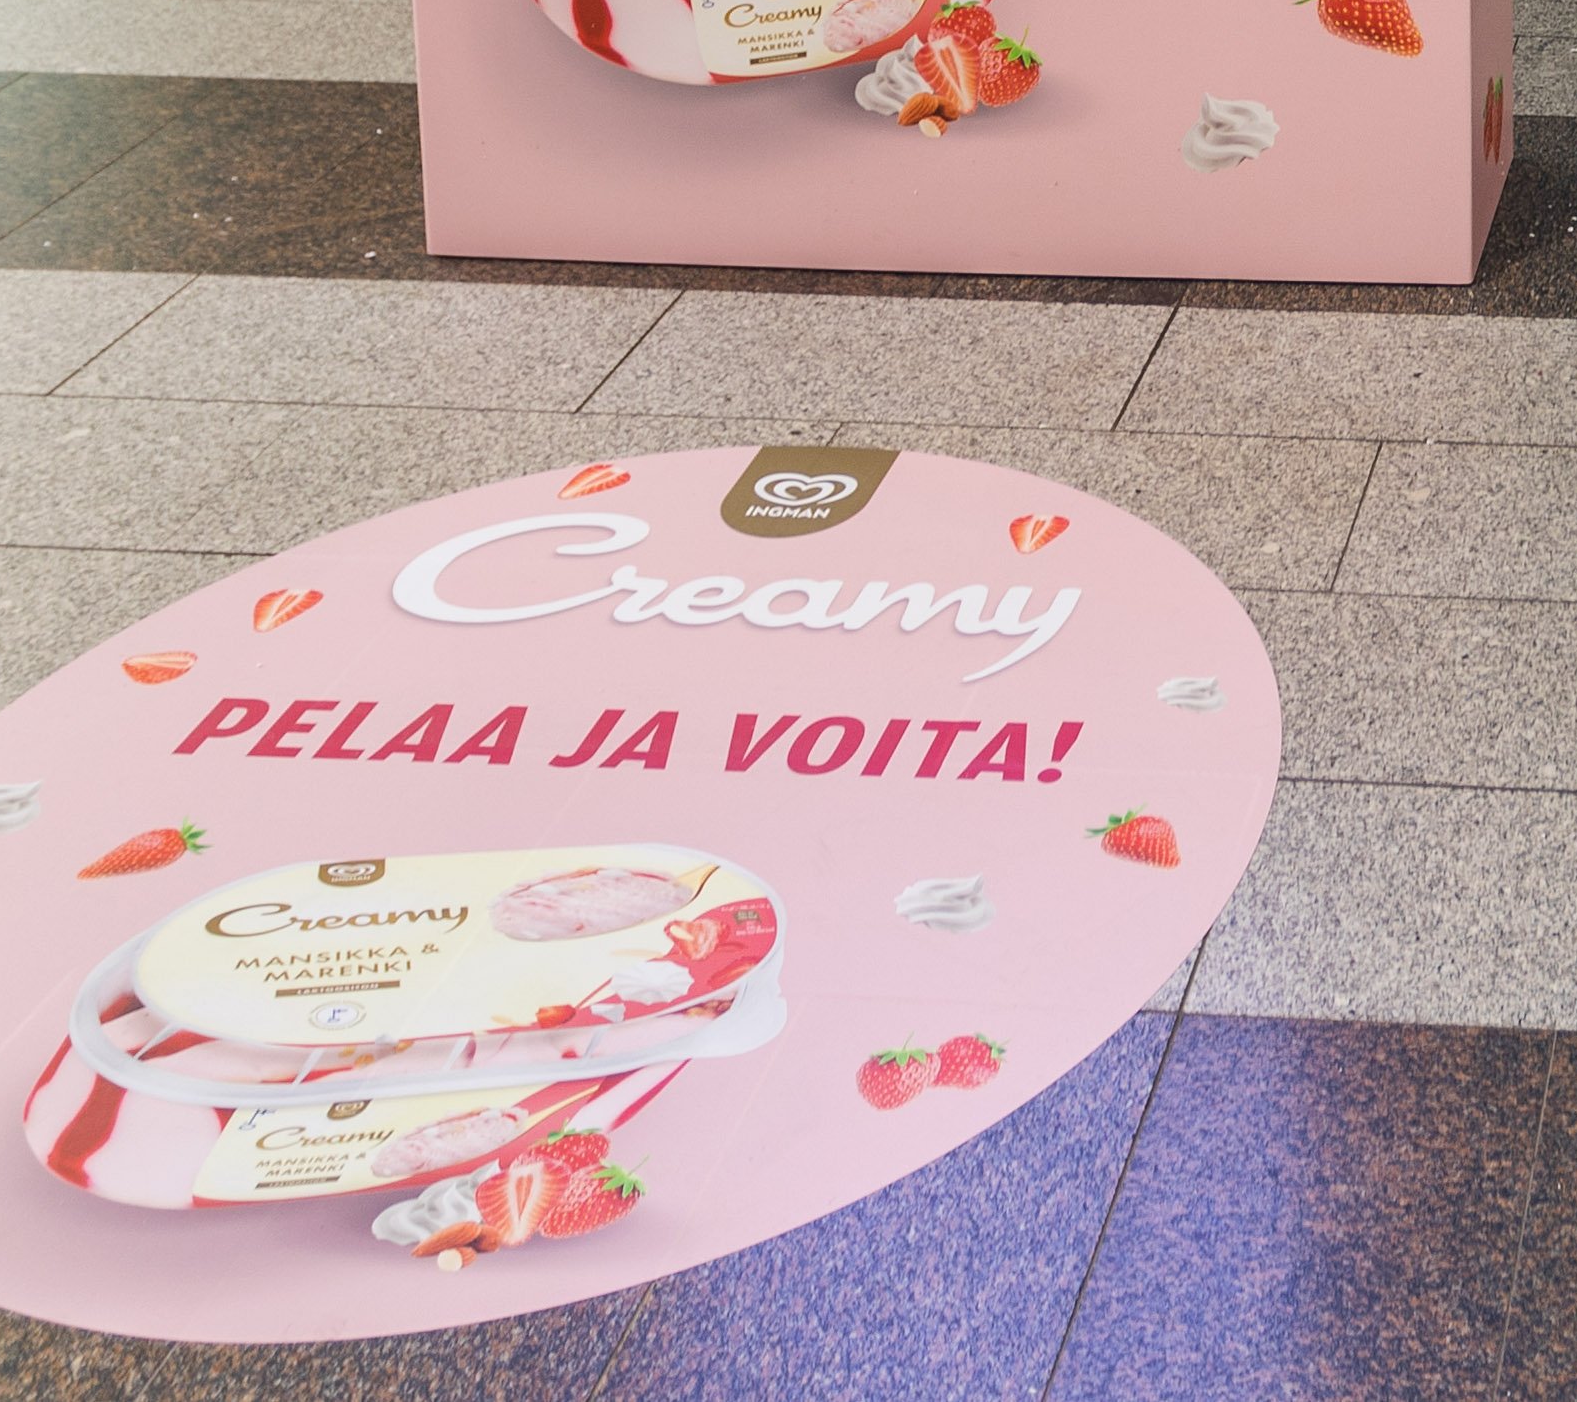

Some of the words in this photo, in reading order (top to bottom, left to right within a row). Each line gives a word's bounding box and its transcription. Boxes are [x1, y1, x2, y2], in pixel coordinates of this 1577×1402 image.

[724, 3, 822, 28] Creamy
[750, 40, 805, 54] MARENKI
[744, 503, 833, 520] INGMAN
[391, 510, 1083, 684] Creamy
[173, 697, 530, 768] PELAA
[549, 705, 679, 772] JA
[721, 713, 1085, 785] VOITA!
[205, 903, 469, 938] Creamy
[234, 946, 409, 971] MANSIKKA
[421, 943, 441, 955] &
[263, 960, 412, 983] MARENKI
[255, 1126, 395, 1151] Creamy
